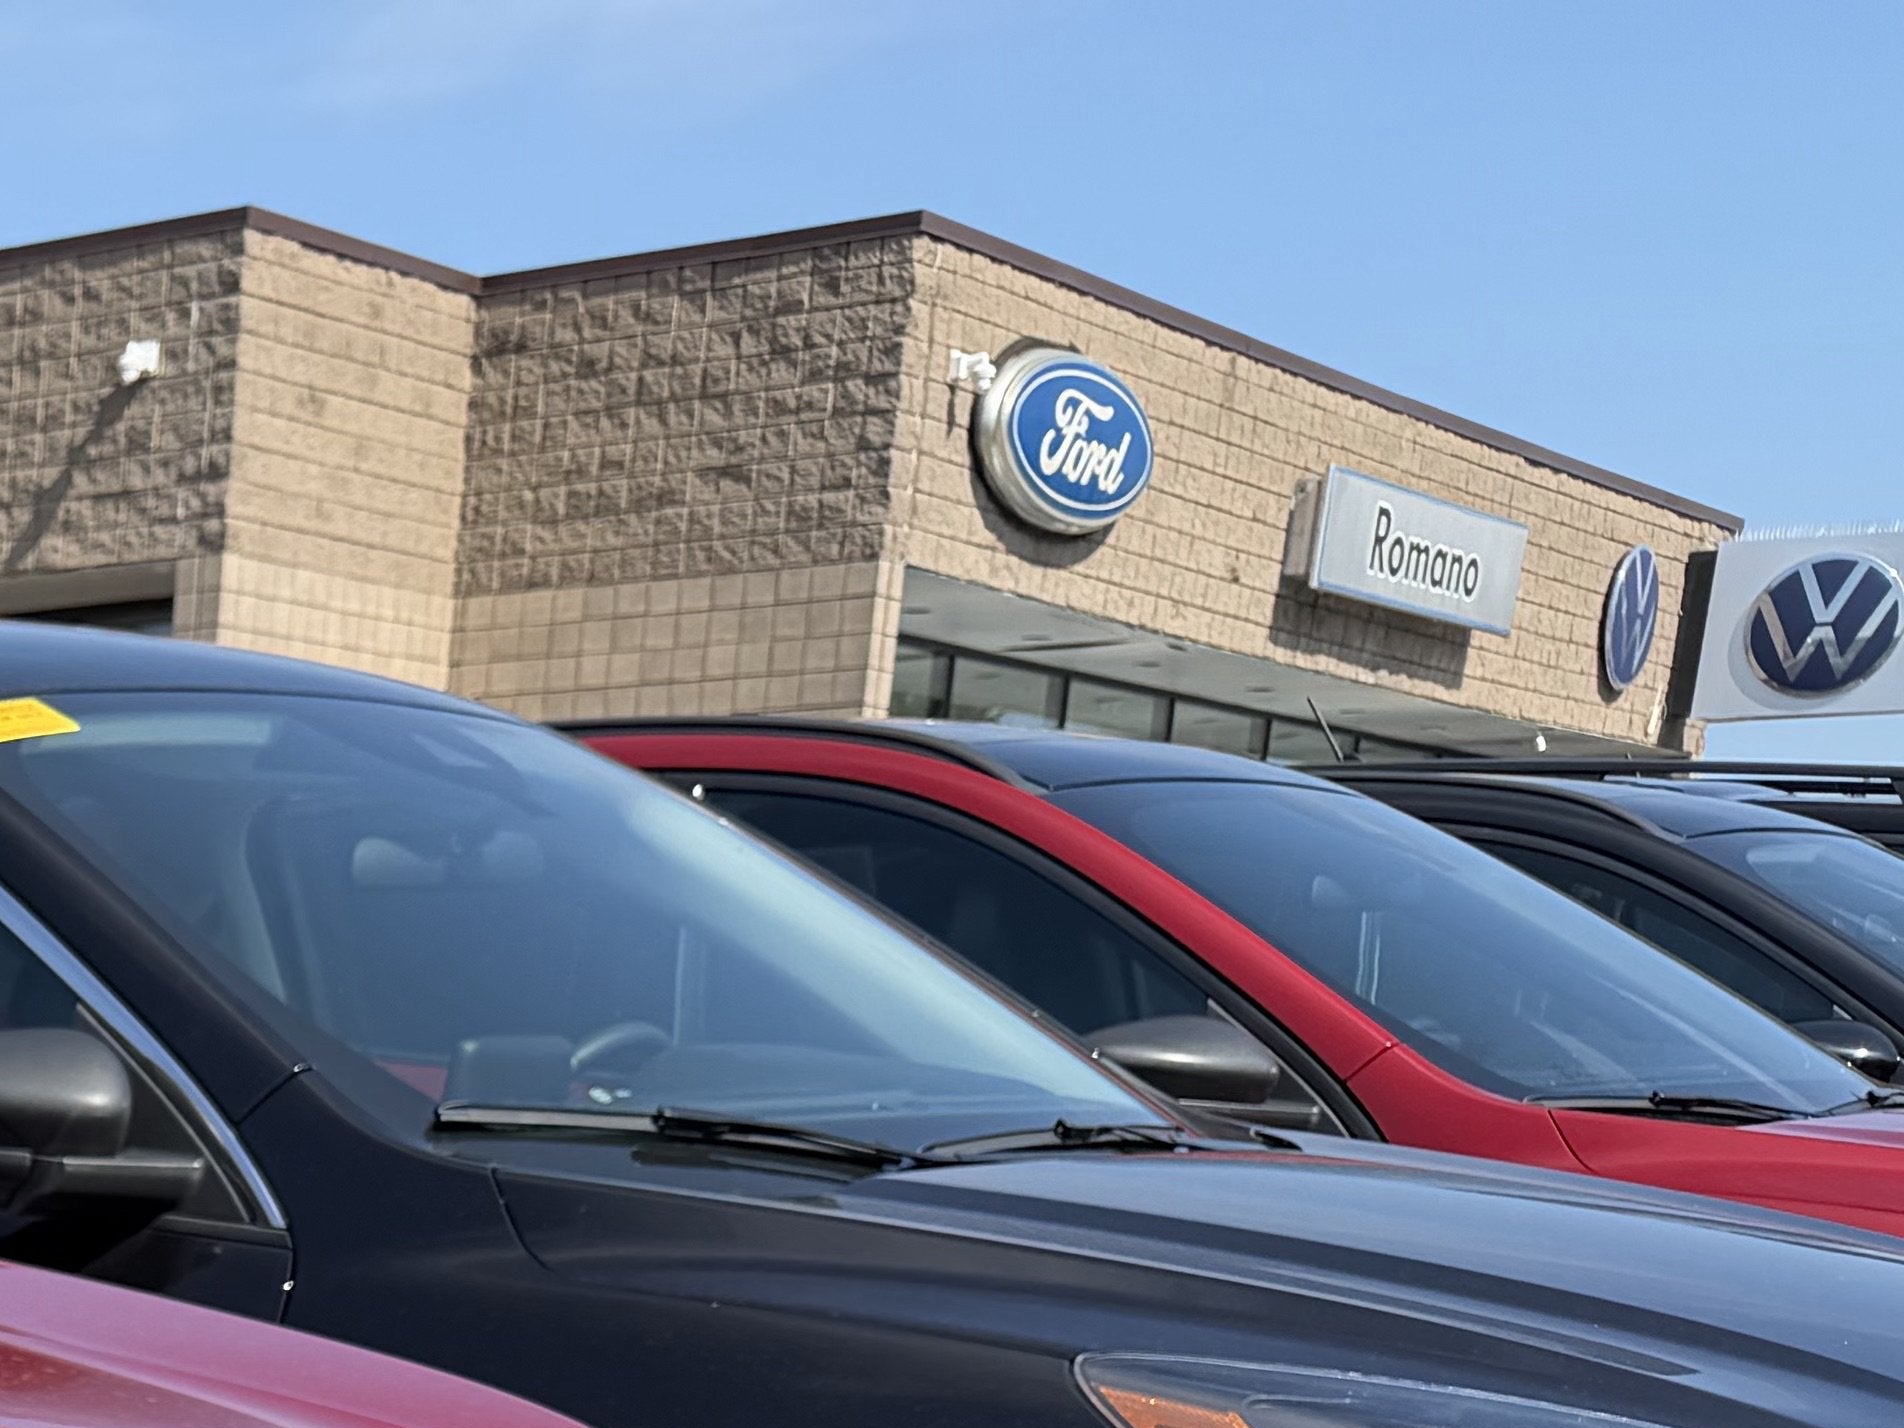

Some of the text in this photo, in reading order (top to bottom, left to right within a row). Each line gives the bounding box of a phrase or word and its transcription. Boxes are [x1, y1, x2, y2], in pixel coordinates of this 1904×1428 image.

[1040, 388, 1132, 494] Ford
[1368, 505, 1480, 598] Romano
[1754, 557, 1899, 685] VW
